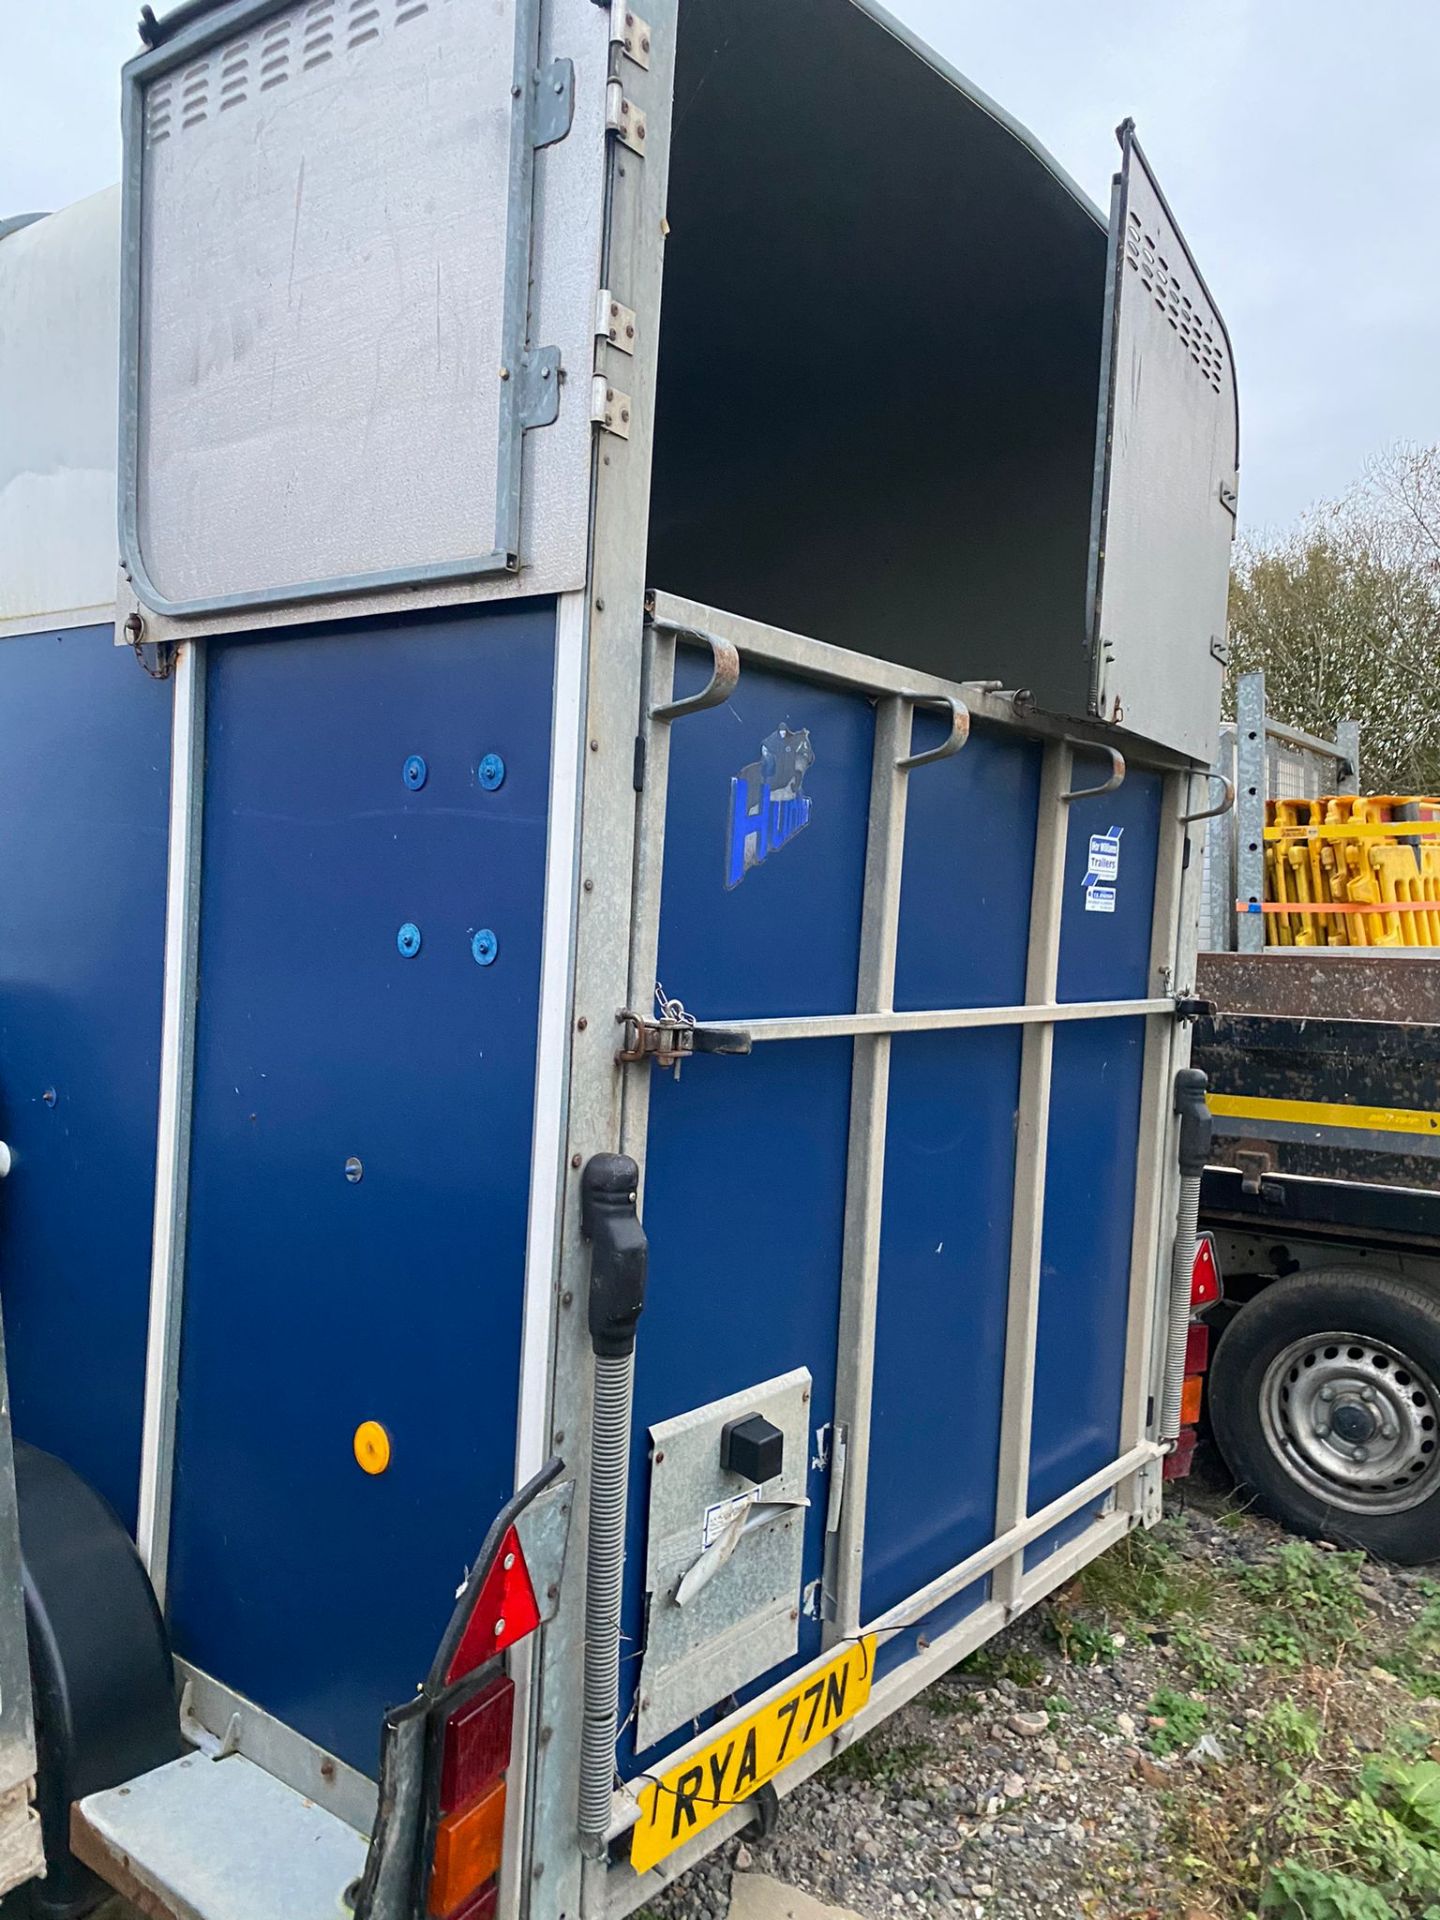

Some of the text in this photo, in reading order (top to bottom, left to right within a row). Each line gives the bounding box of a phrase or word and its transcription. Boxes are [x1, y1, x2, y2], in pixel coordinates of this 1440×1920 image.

[1091, 857, 1116, 869] Trailers
[671, 1726, 757, 1839] RYA
[777, 1661, 849, 1761] 77N
